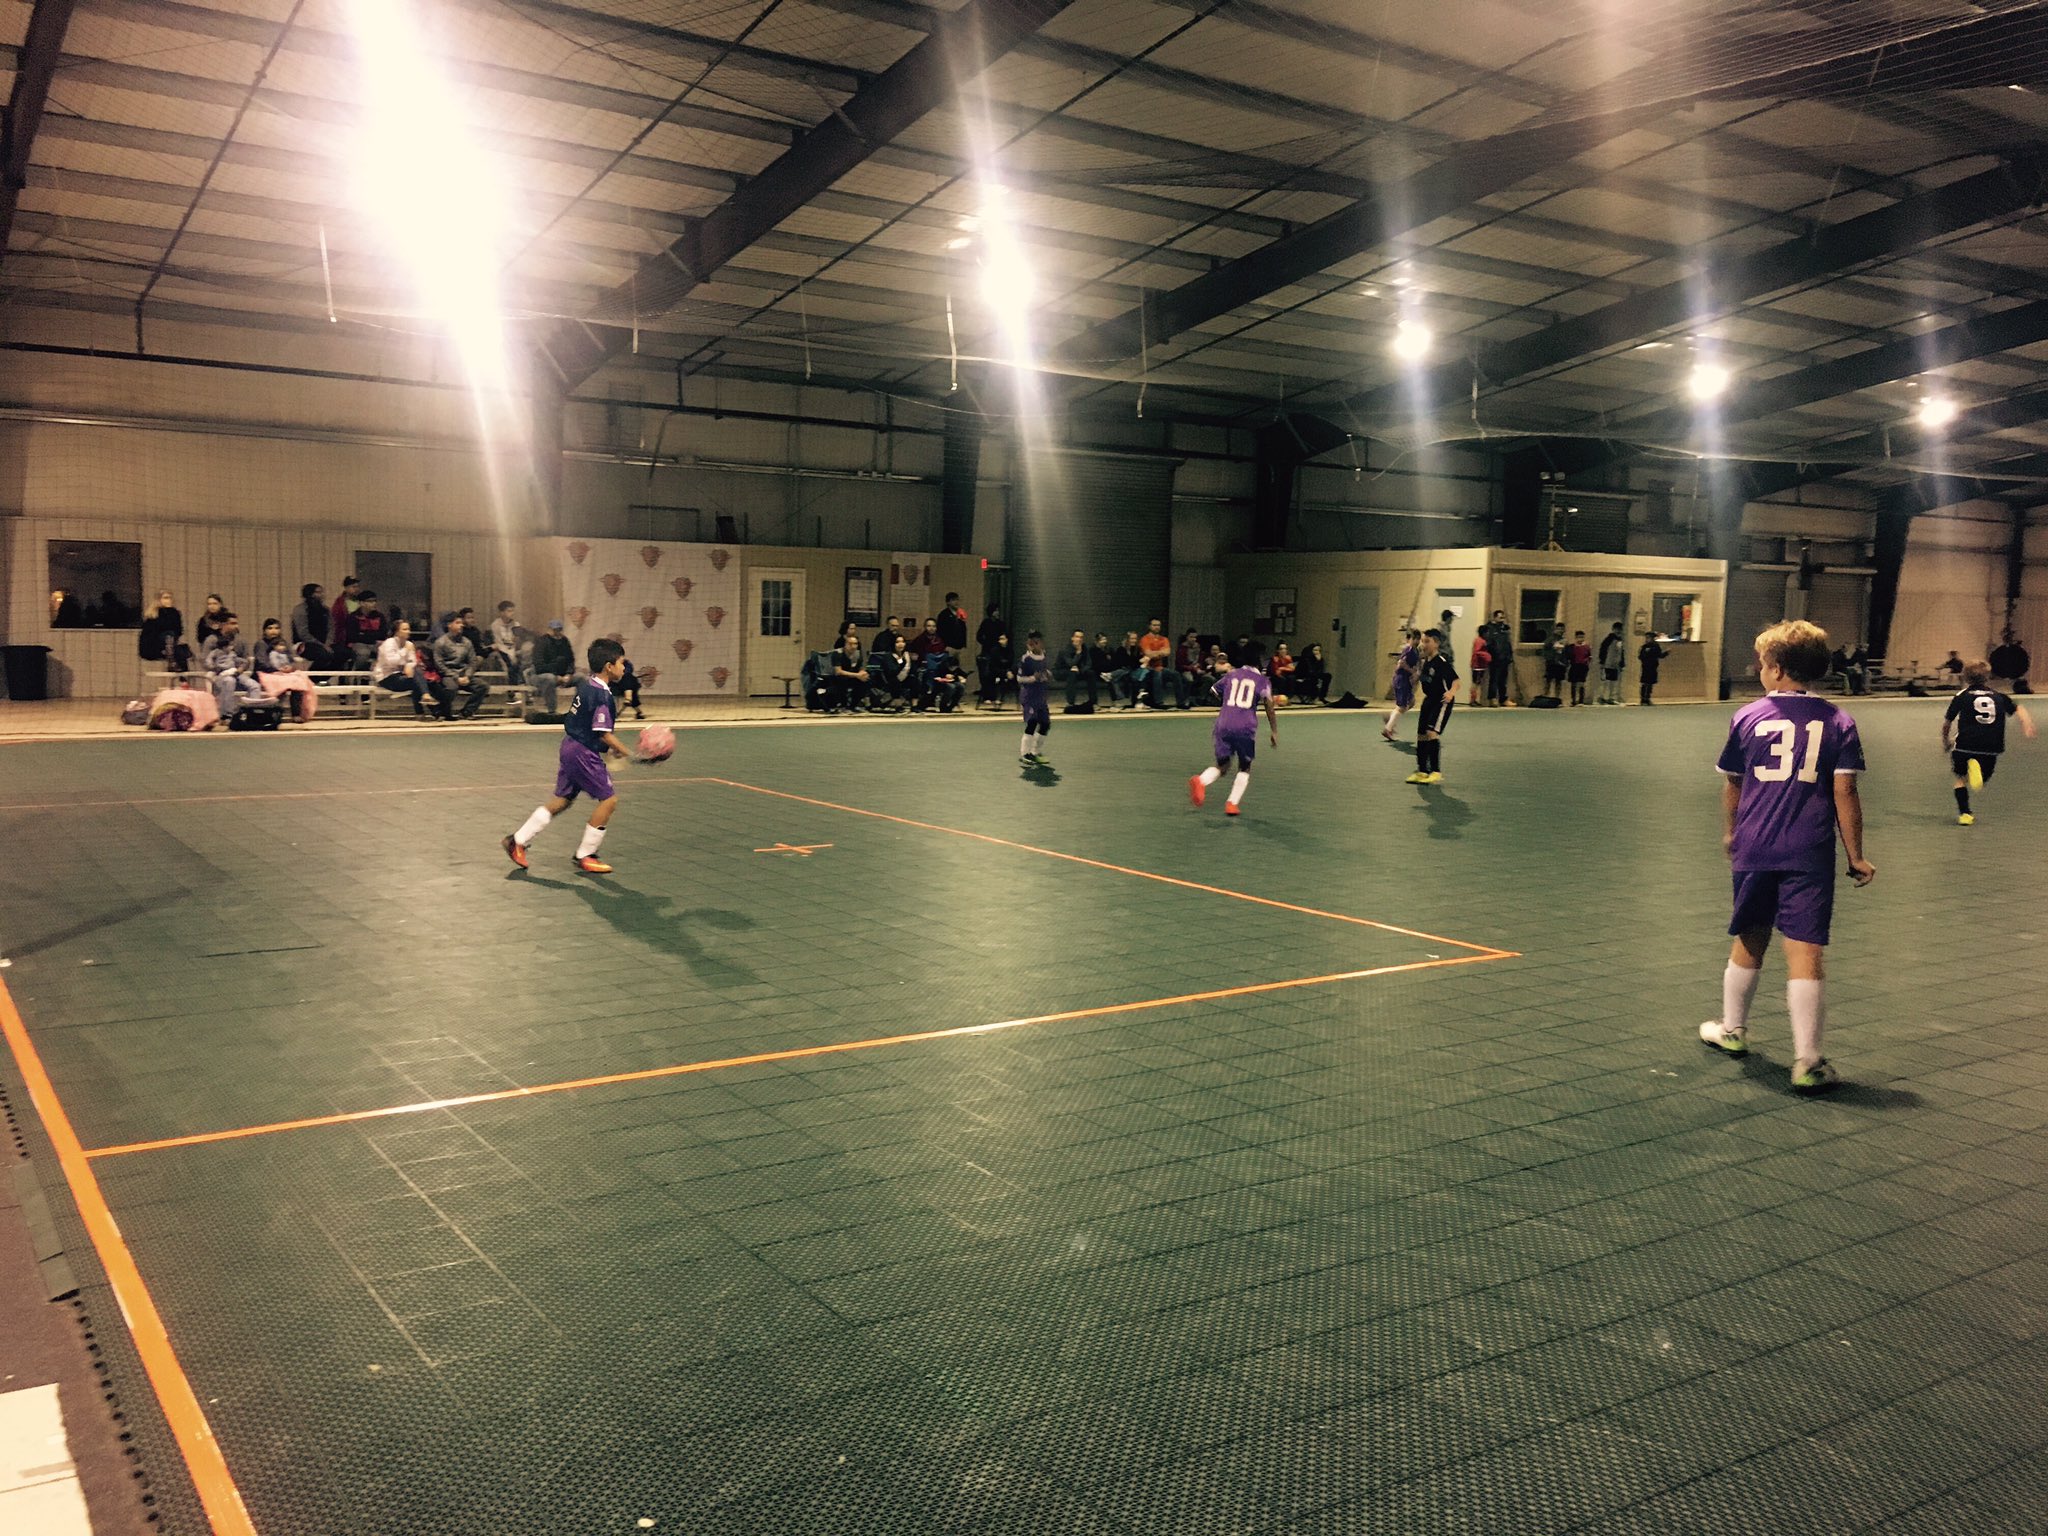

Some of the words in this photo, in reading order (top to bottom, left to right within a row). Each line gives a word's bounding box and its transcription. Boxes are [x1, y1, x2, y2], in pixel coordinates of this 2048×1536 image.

[1227, 678, 1256, 709] 10
[1973, 696, 1996, 725] 9
[1753, 719, 1824, 784] 31
